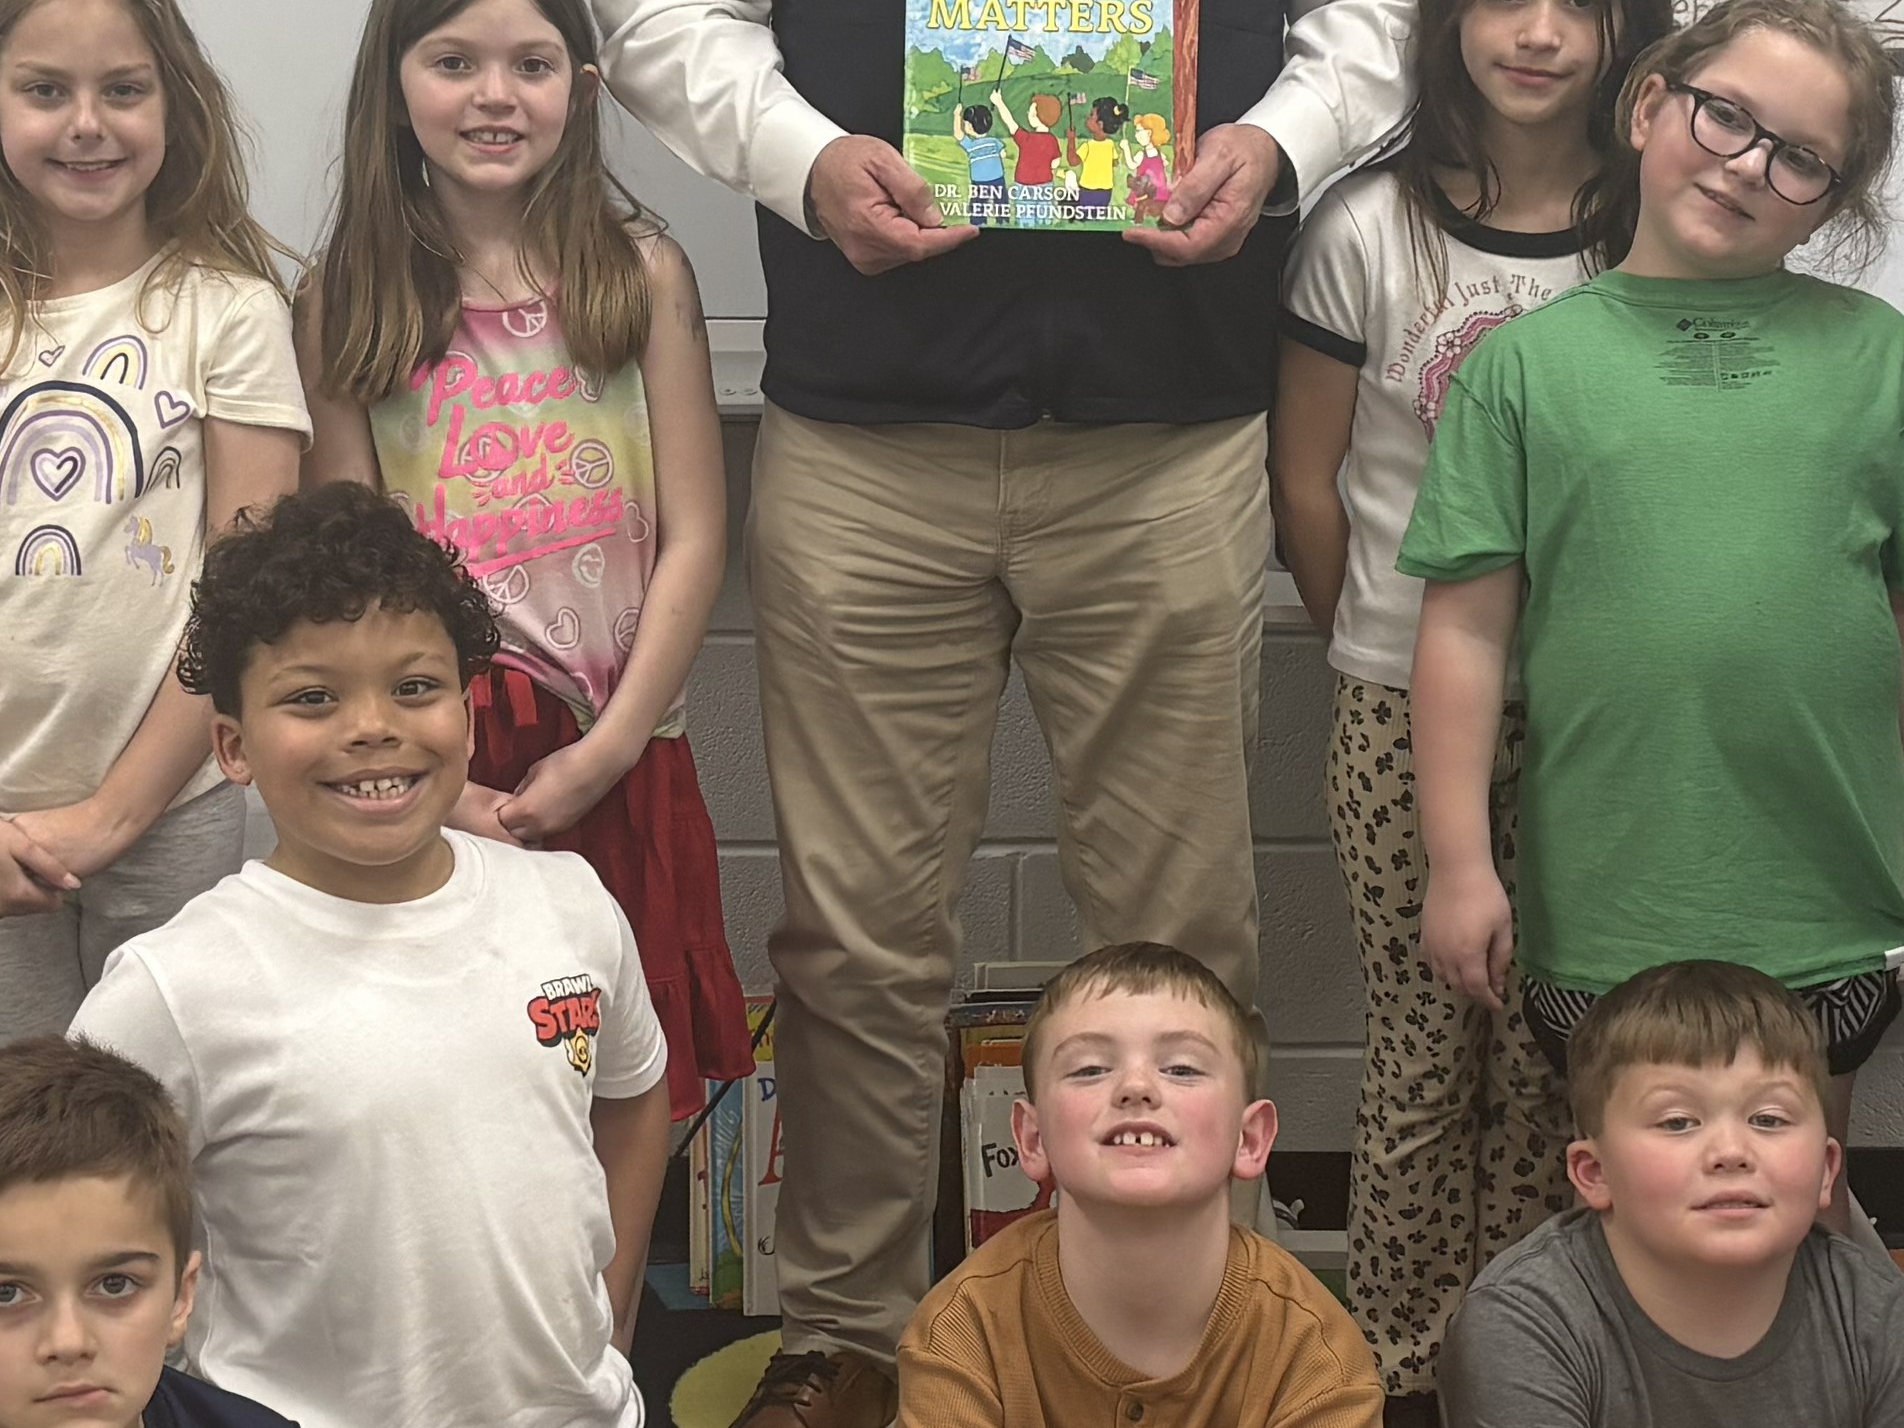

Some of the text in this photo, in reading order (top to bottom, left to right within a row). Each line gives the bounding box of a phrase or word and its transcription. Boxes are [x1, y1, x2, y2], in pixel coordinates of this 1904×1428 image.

[934, 183, 1081, 202] DR. BEN CARSON
[940, 202, 1127, 220] VALERIE PFUNDSTEIN
[1455, 275, 1501, 307] Just
[1510, 273, 1553, 301] The
[410, 353, 577, 427] Peace
[438, 404, 574, 479] Love
[492, 457, 555, 499] and
[416, 483, 624, 560] Happiness
